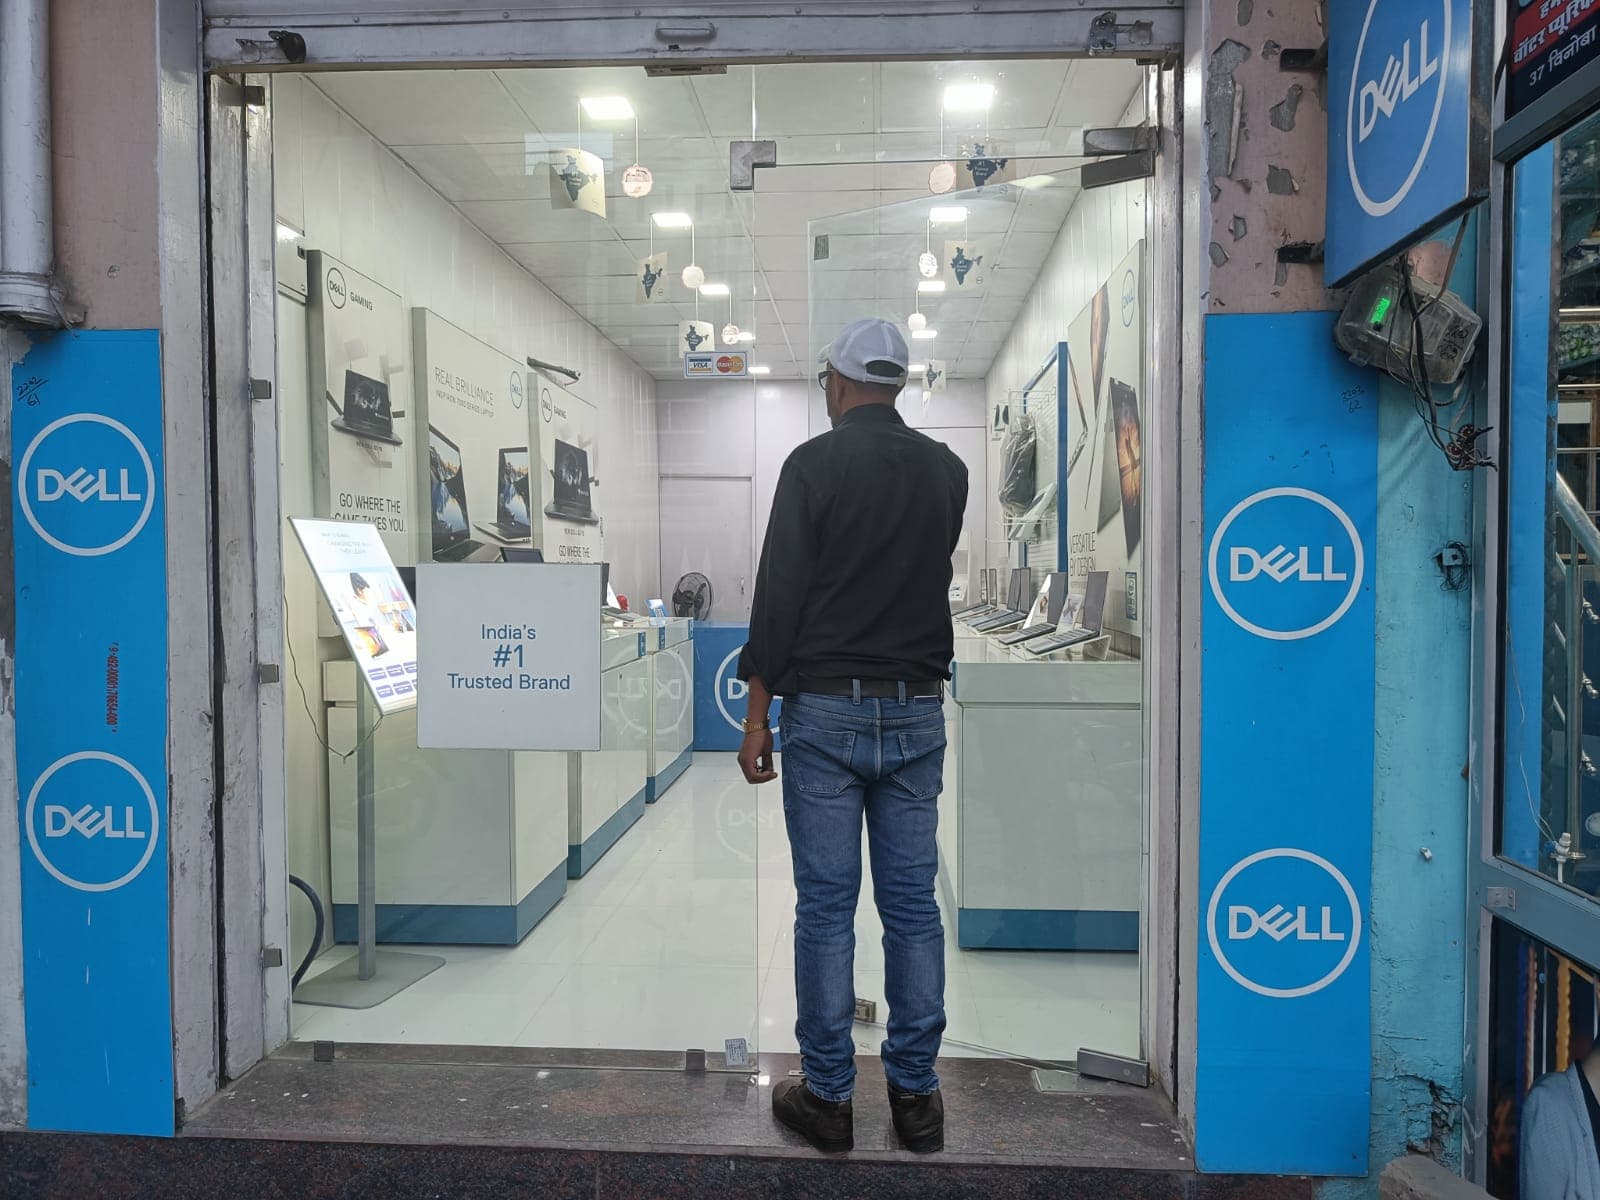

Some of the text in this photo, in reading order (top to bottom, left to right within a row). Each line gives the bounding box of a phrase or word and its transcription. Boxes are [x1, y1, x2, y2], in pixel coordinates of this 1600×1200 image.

[1529, 25, 1597, 86] 37 विनोबा
[1359, 19, 1438, 143] DELL
[329, 280, 373, 311] DELL GAMING
[434, 366, 494, 406] REAL BRILLIANCE
[37, 467, 141, 502] DELL
[339, 492, 401, 514] GO WHERE THE
[388, 519, 406, 532] YOU.
[559, 545, 566, 556] GO
[567, 545, 582, 557] WHERE
[1230, 544, 1347, 583] DELL
[481, 623, 537, 640] India's
[492, 644, 524, 668] #1
[447, 673, 571, 690] Trusted Brand
[44, 804, 146, 839] DELL
[1228, 904, 1345, 942] DELL
